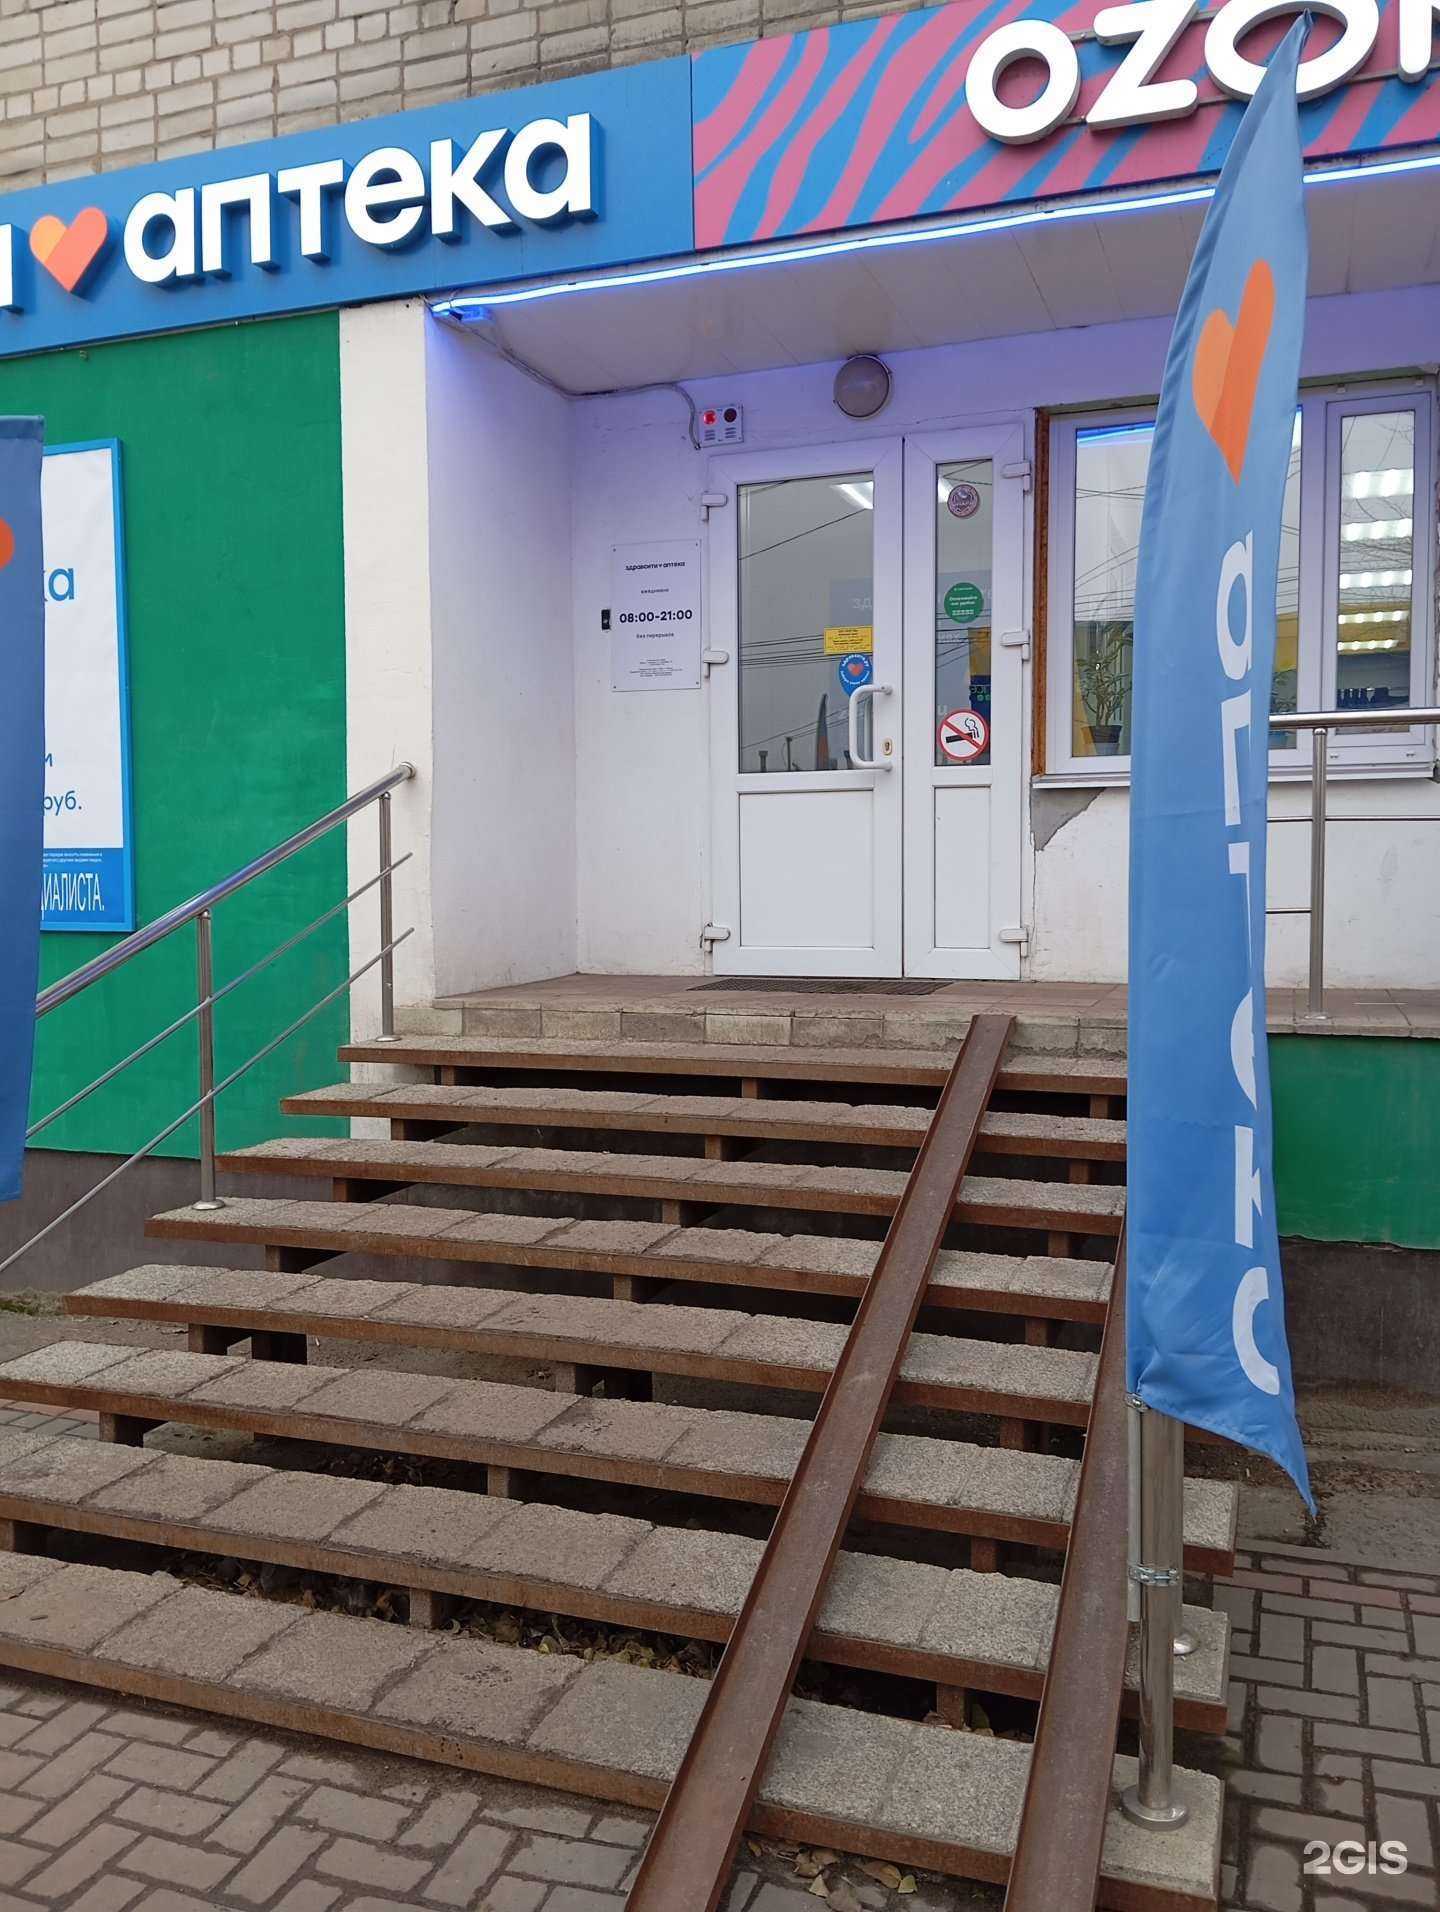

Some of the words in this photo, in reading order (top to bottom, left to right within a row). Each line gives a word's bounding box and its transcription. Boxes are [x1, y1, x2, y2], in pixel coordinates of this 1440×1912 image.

[123, 112, 594, 284] аптека
[620, 610, 692, 623] 08:00-21:00
[41, 872, 105, 913] ИАЛИСТА.
